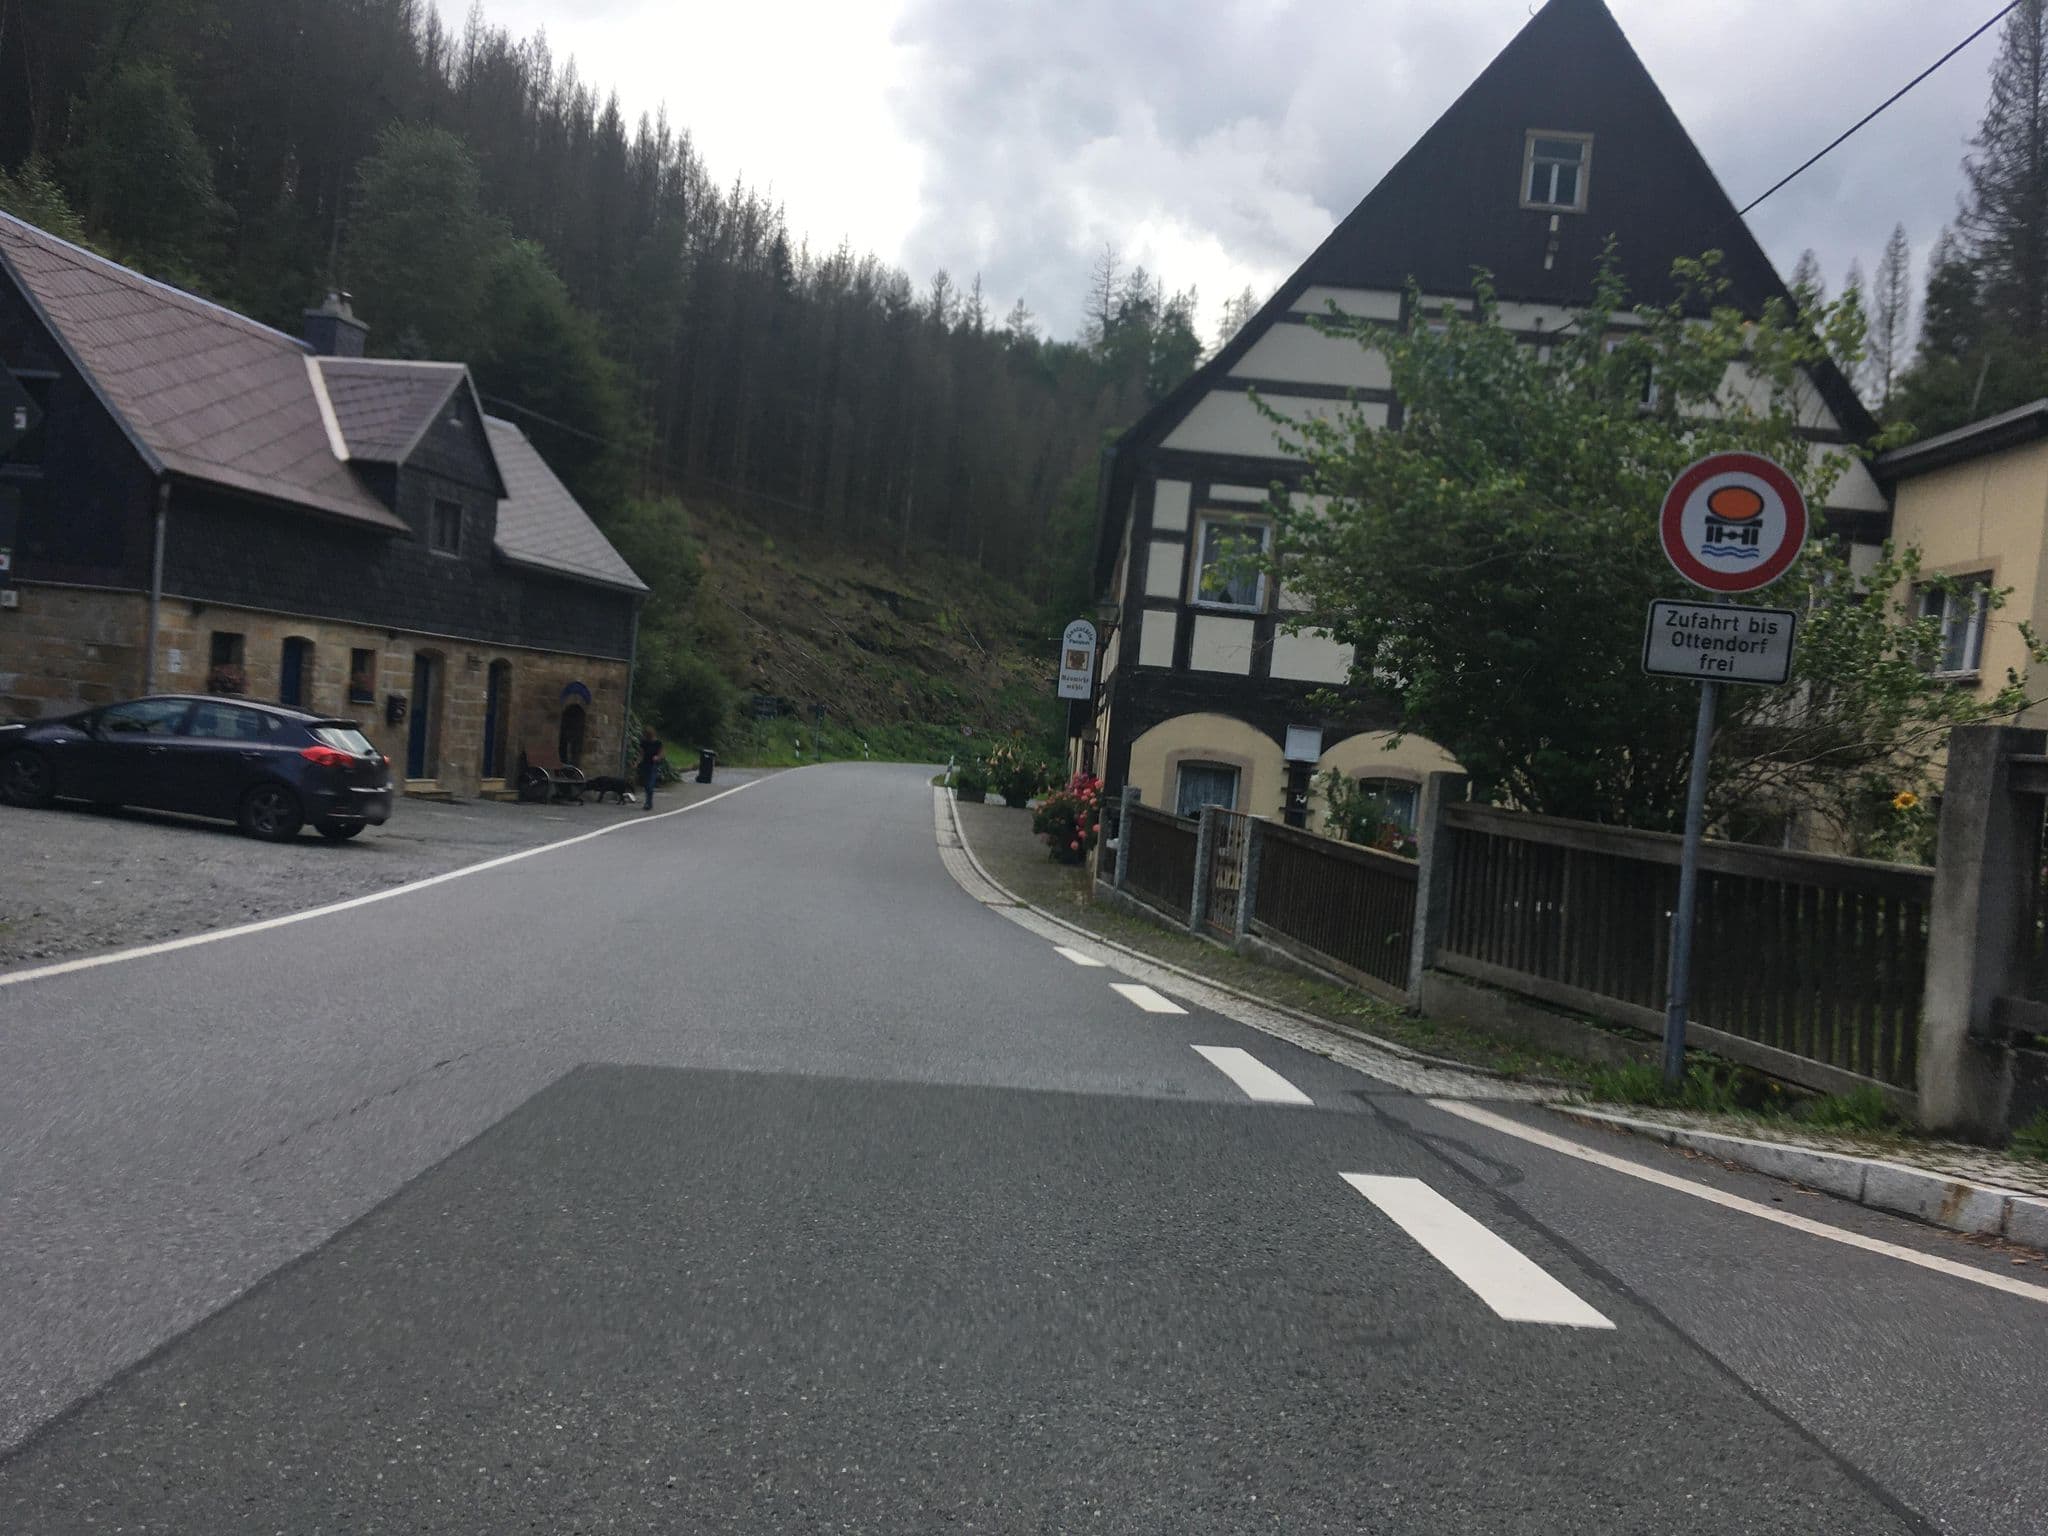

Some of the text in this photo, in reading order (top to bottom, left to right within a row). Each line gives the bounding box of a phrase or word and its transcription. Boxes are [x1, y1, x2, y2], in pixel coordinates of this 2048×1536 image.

[1665, 610, 1778, 635] Zufahrt bis
[1671, 631, 1768, 654] Ottendorf
[1699, 653, 1735, 673] frei
